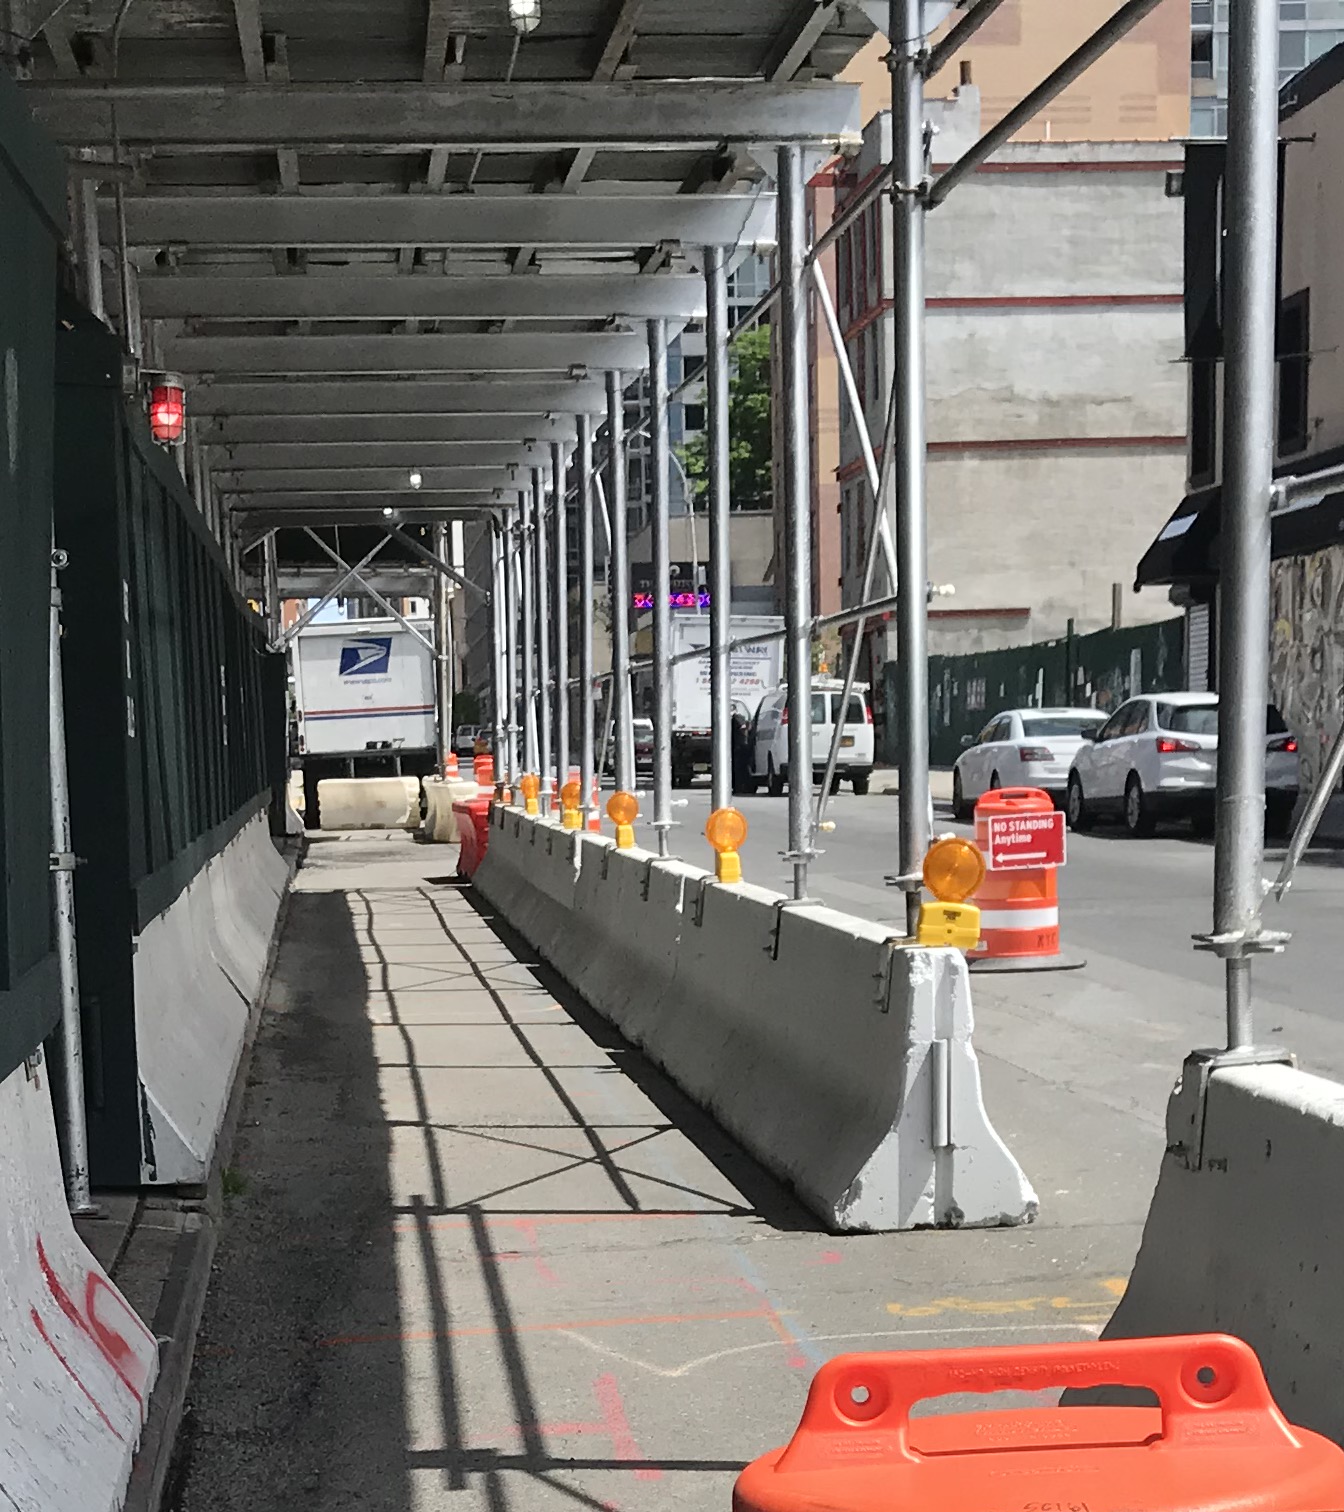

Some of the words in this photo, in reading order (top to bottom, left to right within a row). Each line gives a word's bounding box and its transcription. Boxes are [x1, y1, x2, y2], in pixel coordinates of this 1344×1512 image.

[993, 822, 1007, 832] NO
[1009, 819, 1054, 831] STANDING
[995, 833, 1032, 846] Anytime
